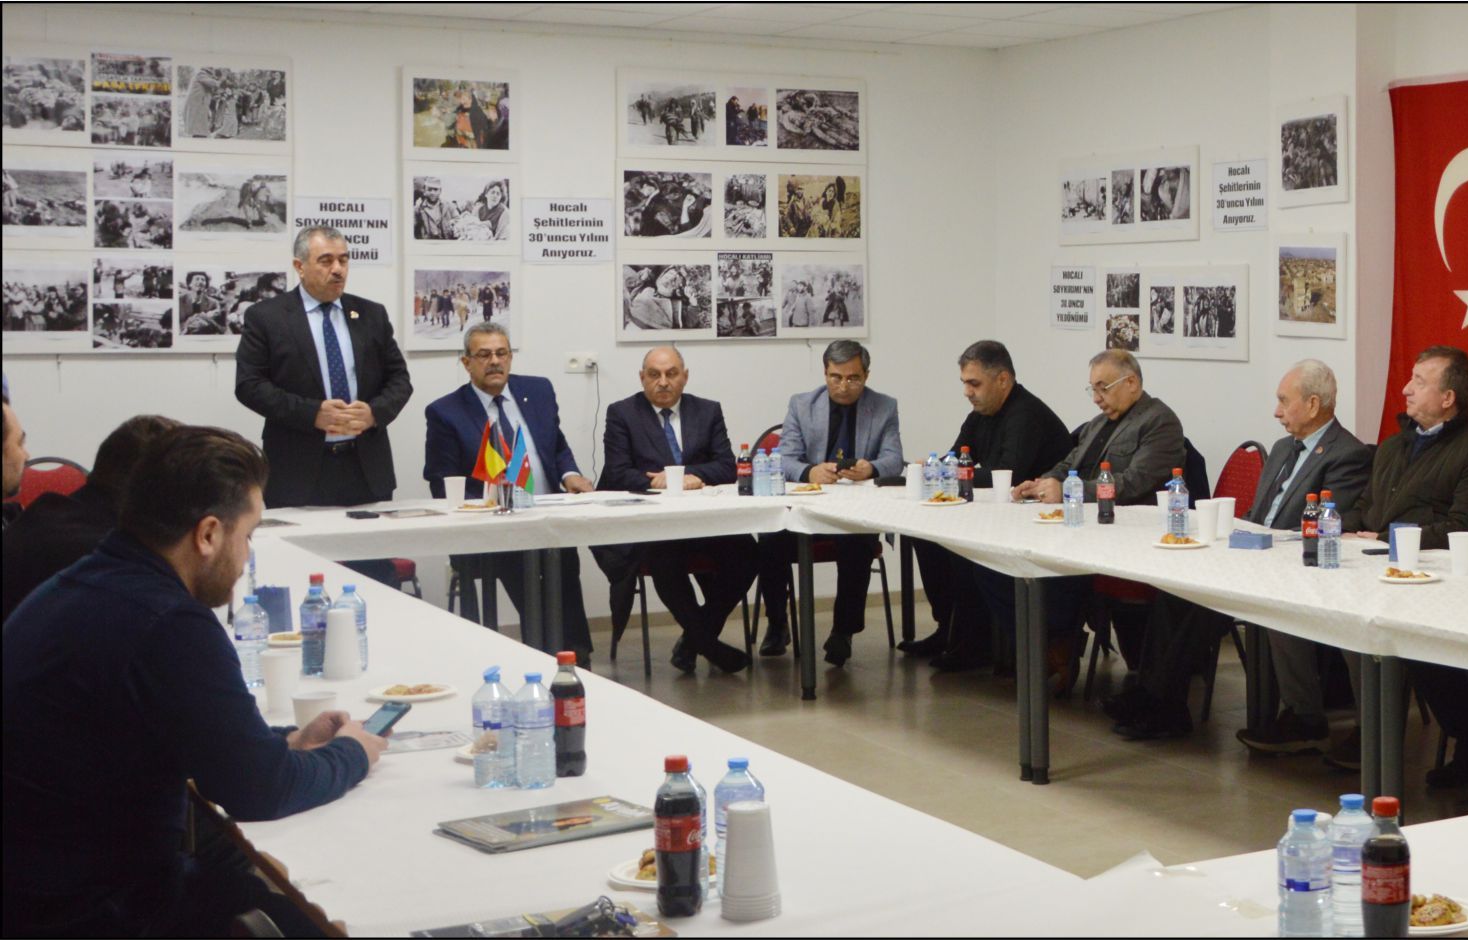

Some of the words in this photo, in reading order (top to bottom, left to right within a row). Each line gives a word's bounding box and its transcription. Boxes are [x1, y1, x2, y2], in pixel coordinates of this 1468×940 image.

[319, 202, 365, 212] HOCALI
[549, 202, 587, 212] Hocalı
[533, 217, 604, 229] Şehitlerinin
[528, 232, 577, 242] 30'uncu
[579, 232, 609, 242] Yılını
[542, 248, 597, 259] Anıyoruz.
